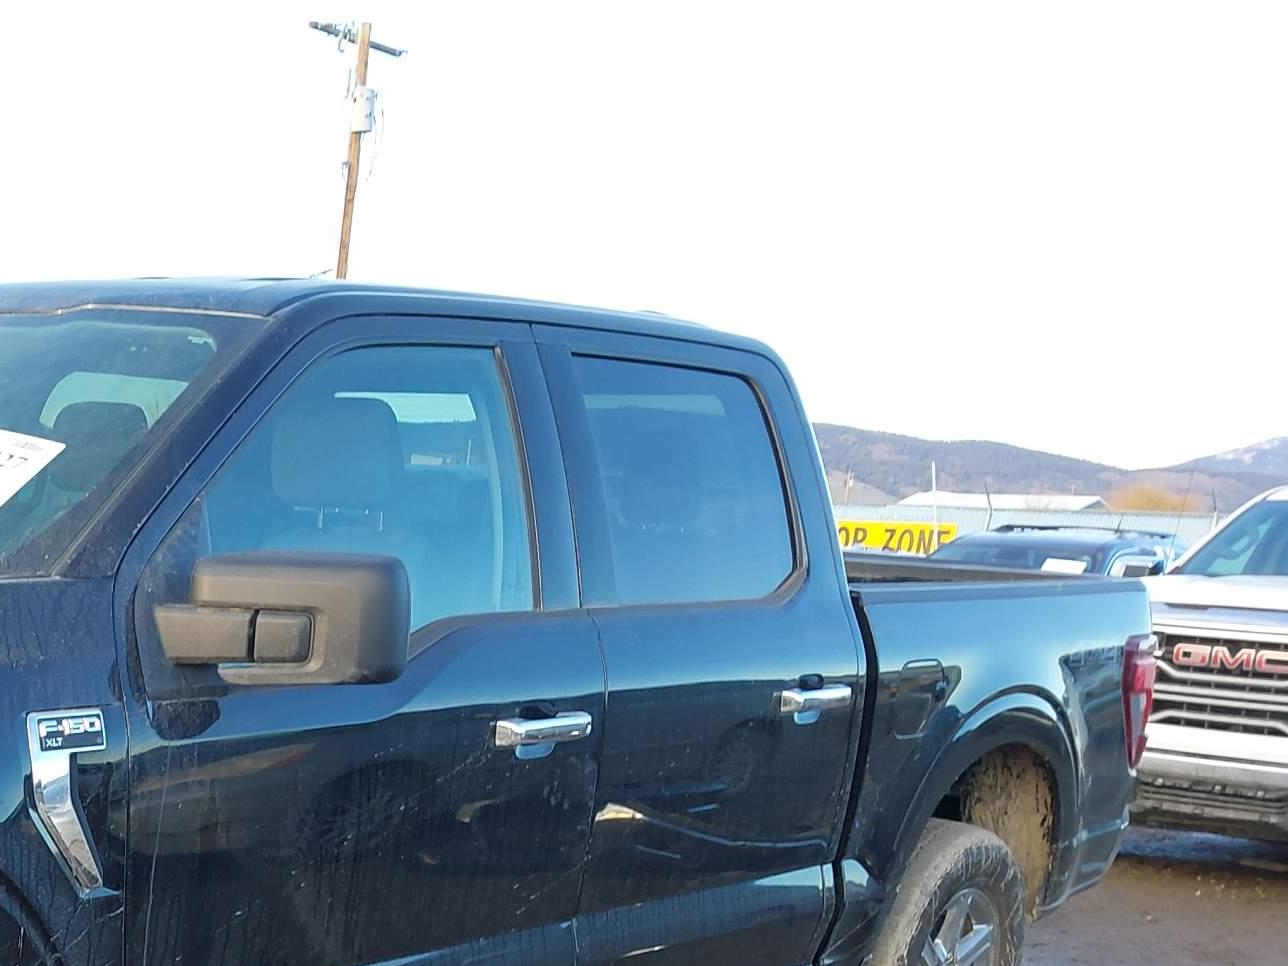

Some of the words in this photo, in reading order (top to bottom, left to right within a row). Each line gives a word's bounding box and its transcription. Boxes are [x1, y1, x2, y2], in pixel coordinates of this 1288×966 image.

[1172, 642, 1288, 674] GMC
[39, 716, 102, 738] F-150
[46, 737, 63, 748] XLT
